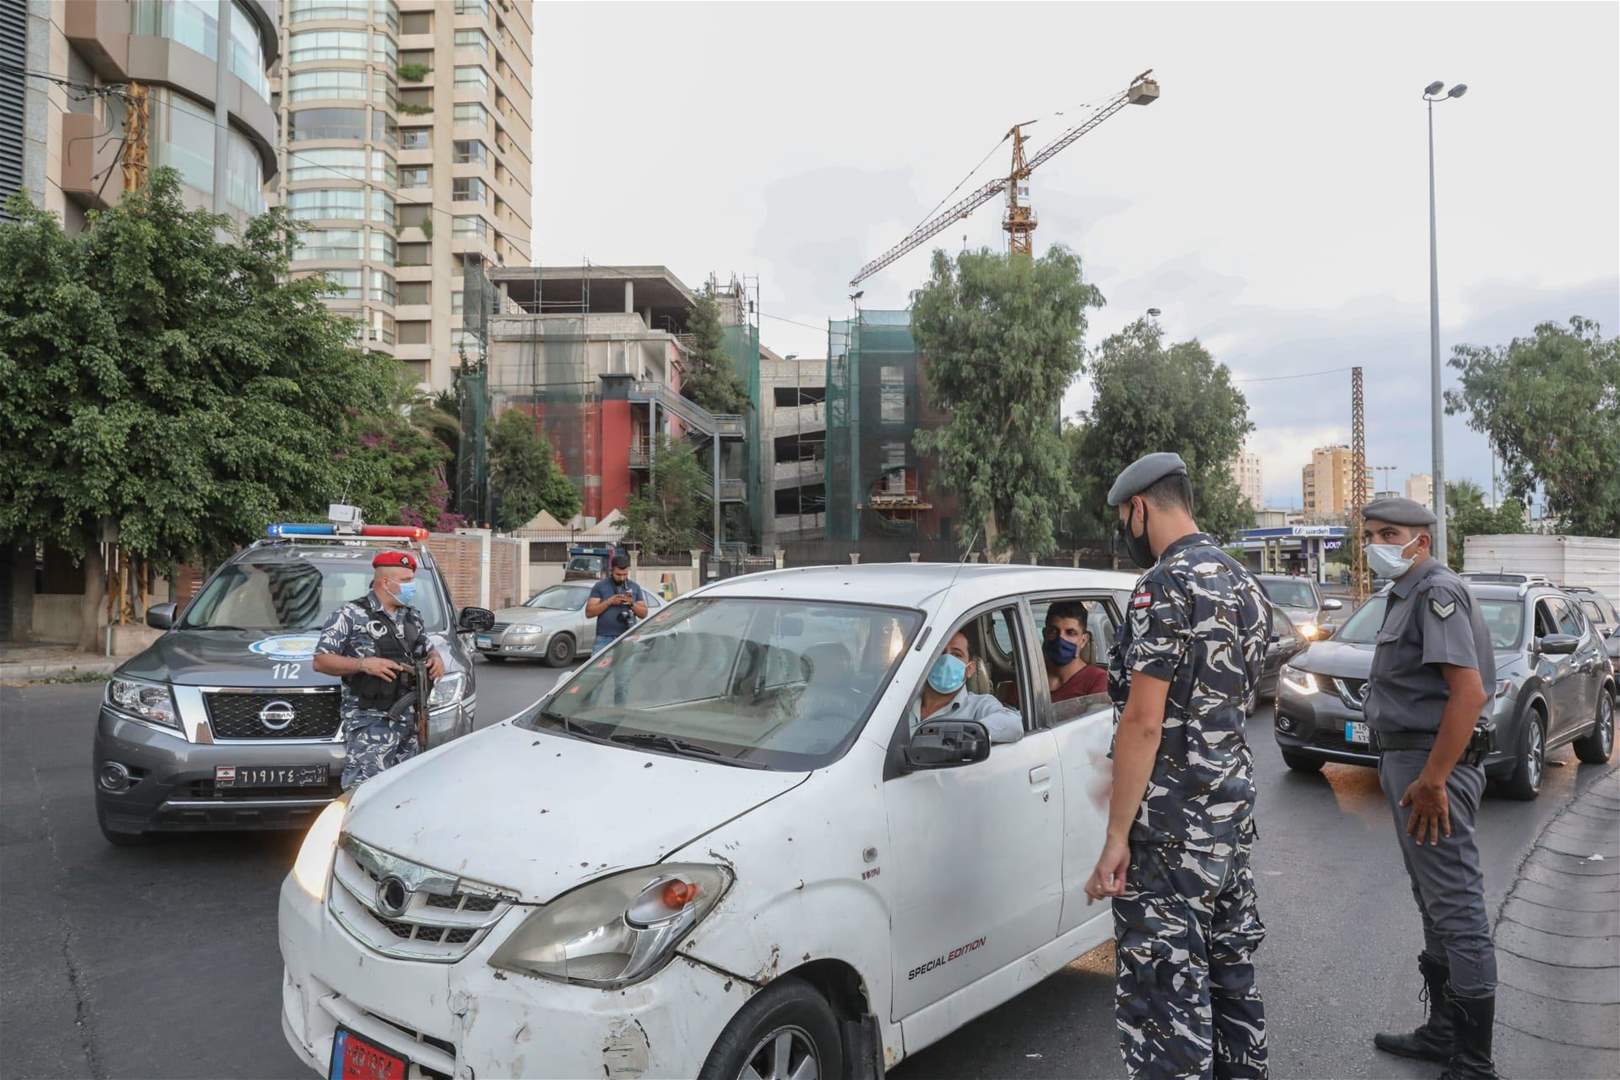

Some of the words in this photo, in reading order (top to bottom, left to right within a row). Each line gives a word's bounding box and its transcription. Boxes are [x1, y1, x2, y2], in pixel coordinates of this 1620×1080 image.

[272, 663, 301, 680] 112
[908, 956, 947, 981] SPECIAL
[946, 936, 987, 962] EDITION
